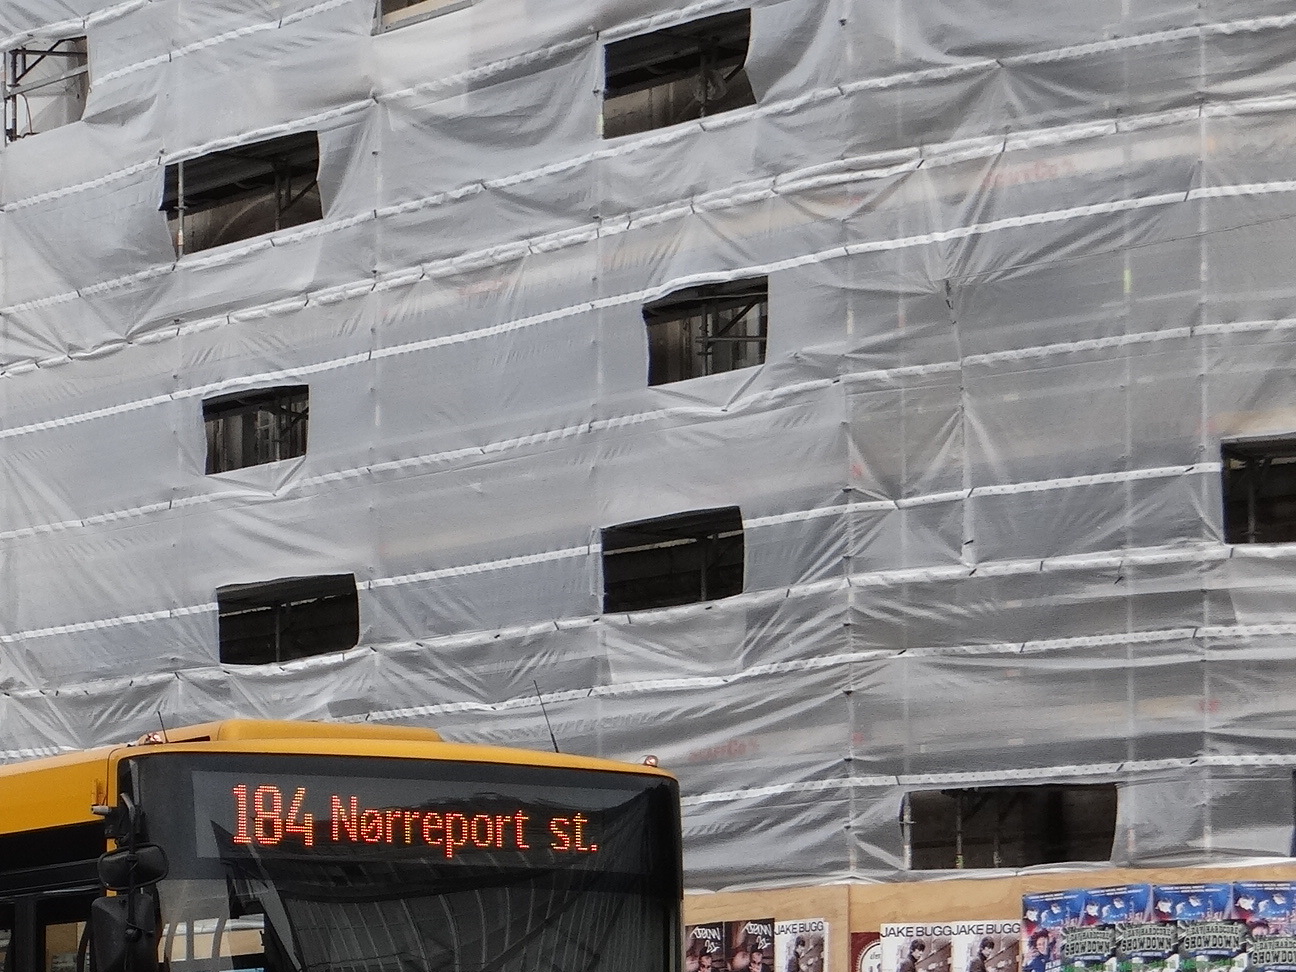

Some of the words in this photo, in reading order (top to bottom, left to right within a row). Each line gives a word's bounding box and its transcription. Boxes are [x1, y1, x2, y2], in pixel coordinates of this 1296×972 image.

[233, 783, 313, 847] 184
[331, 795, 530, 858] Nørreport
[550, 812, 598, 853] st.
[774, 924, 798, 935] JAKE
[799, 921, 824, 932] BUGG
[880, 926, 914, 937] JAKE
[916, 925, 951, 937] BUGG
[951, 924, 984, 936] JAKE
[986, 923, 1021, 934] BUGG
[1065, 940, 1111, 956] SHOWDOWN
[1121, 936, 1173, 951] SHOWDOWN
[1184, 936, 1240, 950] SHOWDOWN
